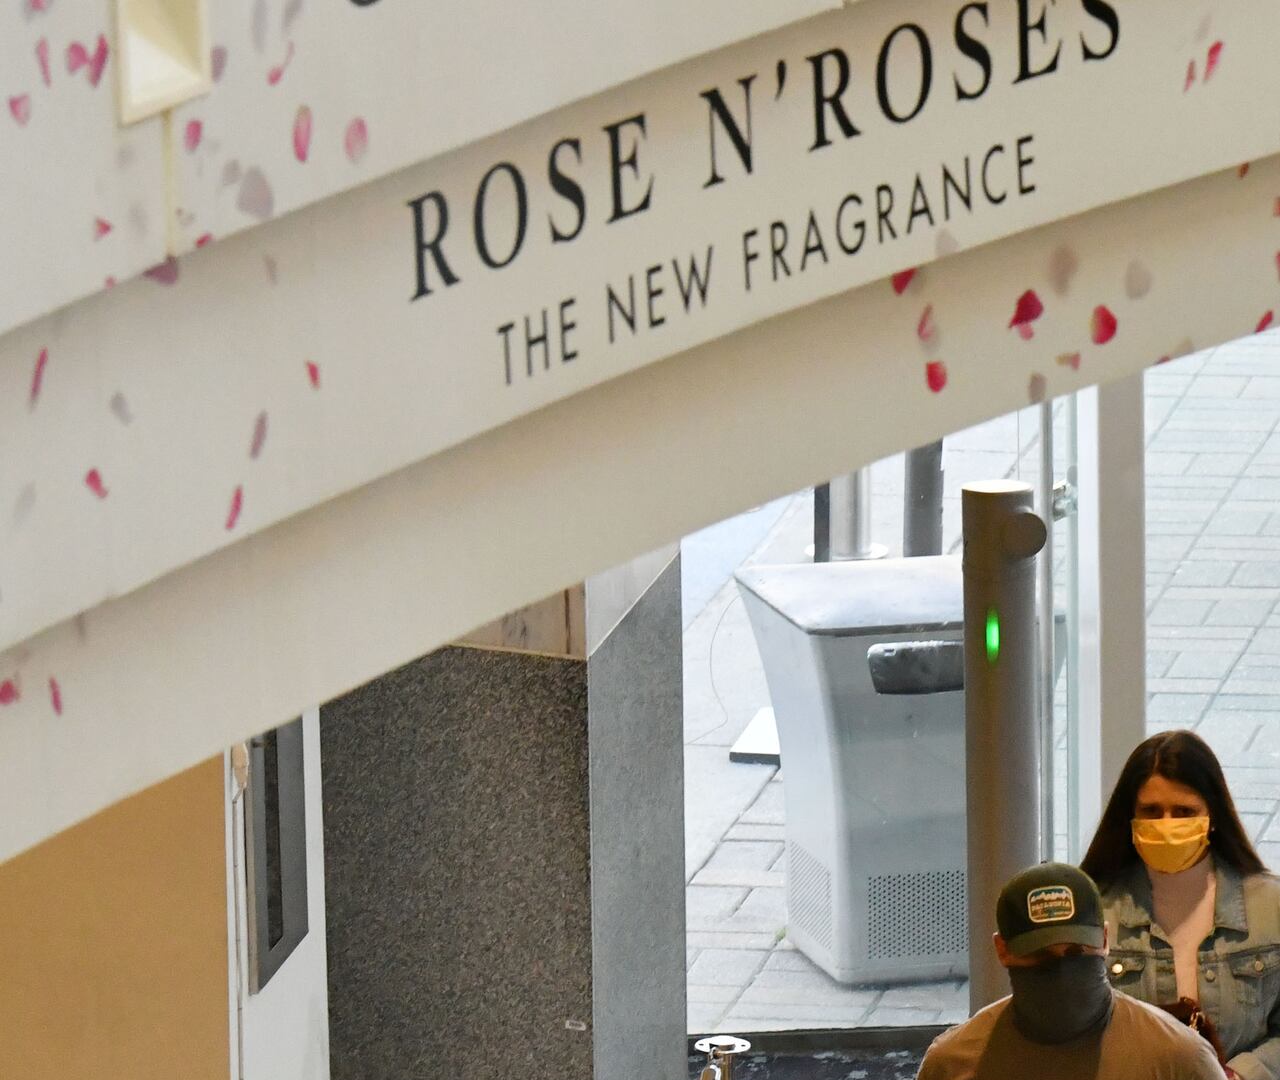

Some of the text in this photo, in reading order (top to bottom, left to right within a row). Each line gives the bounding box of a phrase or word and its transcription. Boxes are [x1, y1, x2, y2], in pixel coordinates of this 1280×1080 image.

[406, 113, 656, 302] ROSE
[497, 135, 1037, 386] THE NEW FRAGRANCE
